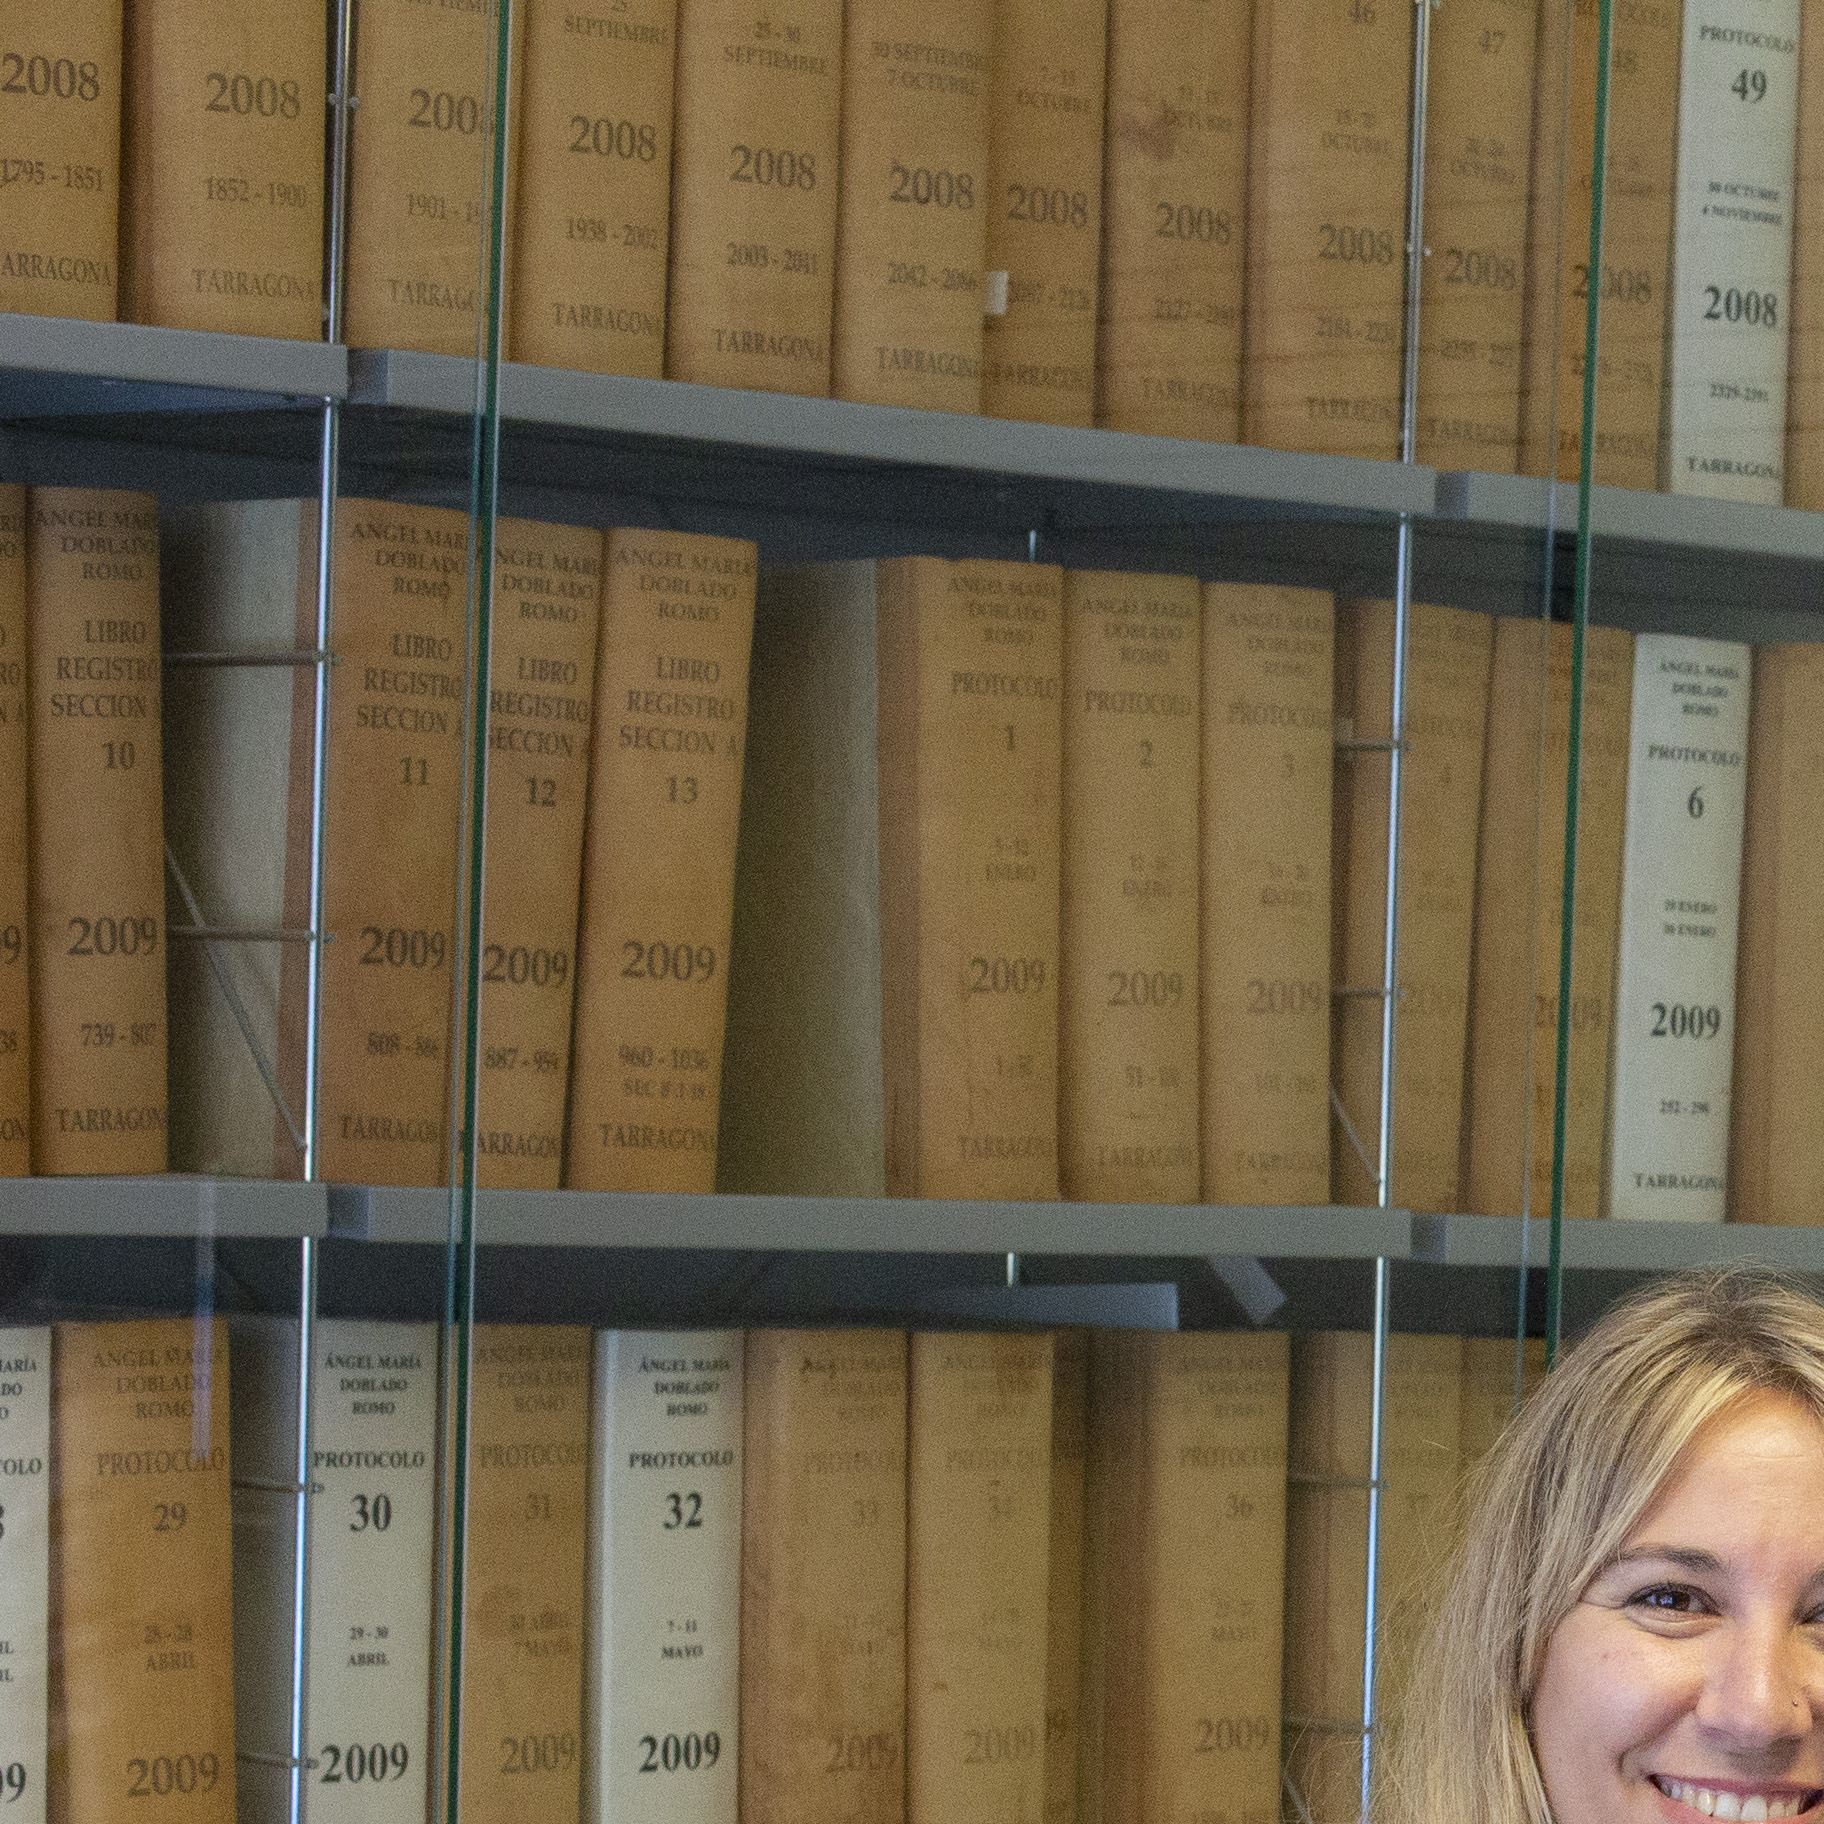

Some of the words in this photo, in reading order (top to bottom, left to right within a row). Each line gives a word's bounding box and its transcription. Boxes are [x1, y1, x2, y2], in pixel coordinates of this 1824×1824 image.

[564, 16, 669, 47] SEPTIEMBRE
[1701, 25, 1794, 52] PROTOCOLO
[723, 47, 828, 77] SEPTIEMBRE
[0, 52, 99, 101] 2008
[1731, 69, 1767, 102] 49
[204, 72, 302, 119] 2008
[569, 115, 658, 163] 2008
[730, 145, 818, 191] 2008
[888, 165, 975, 210] 2008
[1007, 184, 1088, 227] 2008
[1156, 201, 1232, 245] 2008
[1319, 224, 1394, 266] 2008
[1443, 247, 1515, 292] 2008
[1702, 287, 1777, 329] 2008
[1688, 457, 1781, 478] TARRAGONA
[83, 561, 142, 581] ROMO
[375, 550, 464, 575] DOBLADO
[395, 576, 451, 599] ROMO
[502, 575, 594, 597] DOBLADO
[639, 575, 736, 599] DOBLADO
[519, 601, 577, 623] ROMO
[658, 602, 719, 622] ROMO
[85, 621, 146, 644] LIBRO
[394, 634, 452, 661] LIBRO
[58, 657, 156, 682] REGISTRO
[364, 668, 462, 699] REGISTRO
[518, 658, 577, 686] LIBRO
[656, 656, 720, 683] LIBRO
[953, 671, 1059, 698] PROTOCOLO
[1672, 684, 1727, 697] DOBLADO
[50, 694, 146, 718] SECCION
[490, 691, 587, 723] REGISTRO
[628, 690, 736, 722] REGISTRO
[1084, 690, 1193, 718] PROTOCOLO
[357, 705, 447, 735] SECCION
[619, 726, 715, 756] SECCION
[1005, 724, 1015, 751] 1
[102, 741, 135, 770] 10
[1140, 741, 1153, 767] 2
[1282, 754, 1294, 778] 3
[1649, 747, 1740, 766] PROTOCOLO
[399, 757, 429, 786] 11
[524, 778, 557, 807] 12
[665, 776, 698, 804] 13
[1687, 787, 1704, 818] 6
[68, 916, 157, 956] 2009
[359, 926, 447, 969] 2009
[483, 945, 567, 988] 2009
[621, 941, 716, 982] 2009
[970, 957, 1045, 995] 2009
[1107, 970, 1184, 1009] 2009
[1248, 980, 1322, 1015] 2009
[80, 1024, 114, 1046] 739
[1651, 1003, 1721, 1039] 2009
[619, 1045, 653, 1071] 960
[1634, 1173, 1725, 1191] TARRAGONA
[326, 1353, 372, 1369] ÁNGEL
[378, 1353, 422, 1371] MARÍA
[117, 1372, 211, 1393] DOBLADO
[341, 1378, 408, 1392] DOBLADO
[655, 1379, 720, 1396] DOBLADO
[136, 1401, 193, 1418] ROMO
[352, 1401, 395, 1415] ROMO
[667, 1403, 707, 1416] ROMO
[98, 1447, 225, 1475] PROTOCOLO
[313, 1451, 424, 1469] PROTOCOLO
[629, 1451, 733, 1468] PROTOCOLO
[153, 1505, 187, 1532] 29
[349, 1494, 392, 1533] 30
[524, 1493, 551, 1520] 31
[663, 1493, 703, 1529] 32
[1226, 1494, 1254, 1520] 36
[146, 1652, 197, 1672] ABRIL
[347, 1652, 390, 1667] ABRIL
[662, 1646, 701, 1658] MAYO
[964, 1724, 1036, 1765] 2009
[1194, 1716, 1271, 1754] 2009
[321, 1745, 409, 1784] 2009
[501, 1732, 576, 1775] 2009
[639, 1732, 721, 1772] 2009
[826, 1735, 897, 1774] 2009
[126, 1754, 221, 1799] 2009
